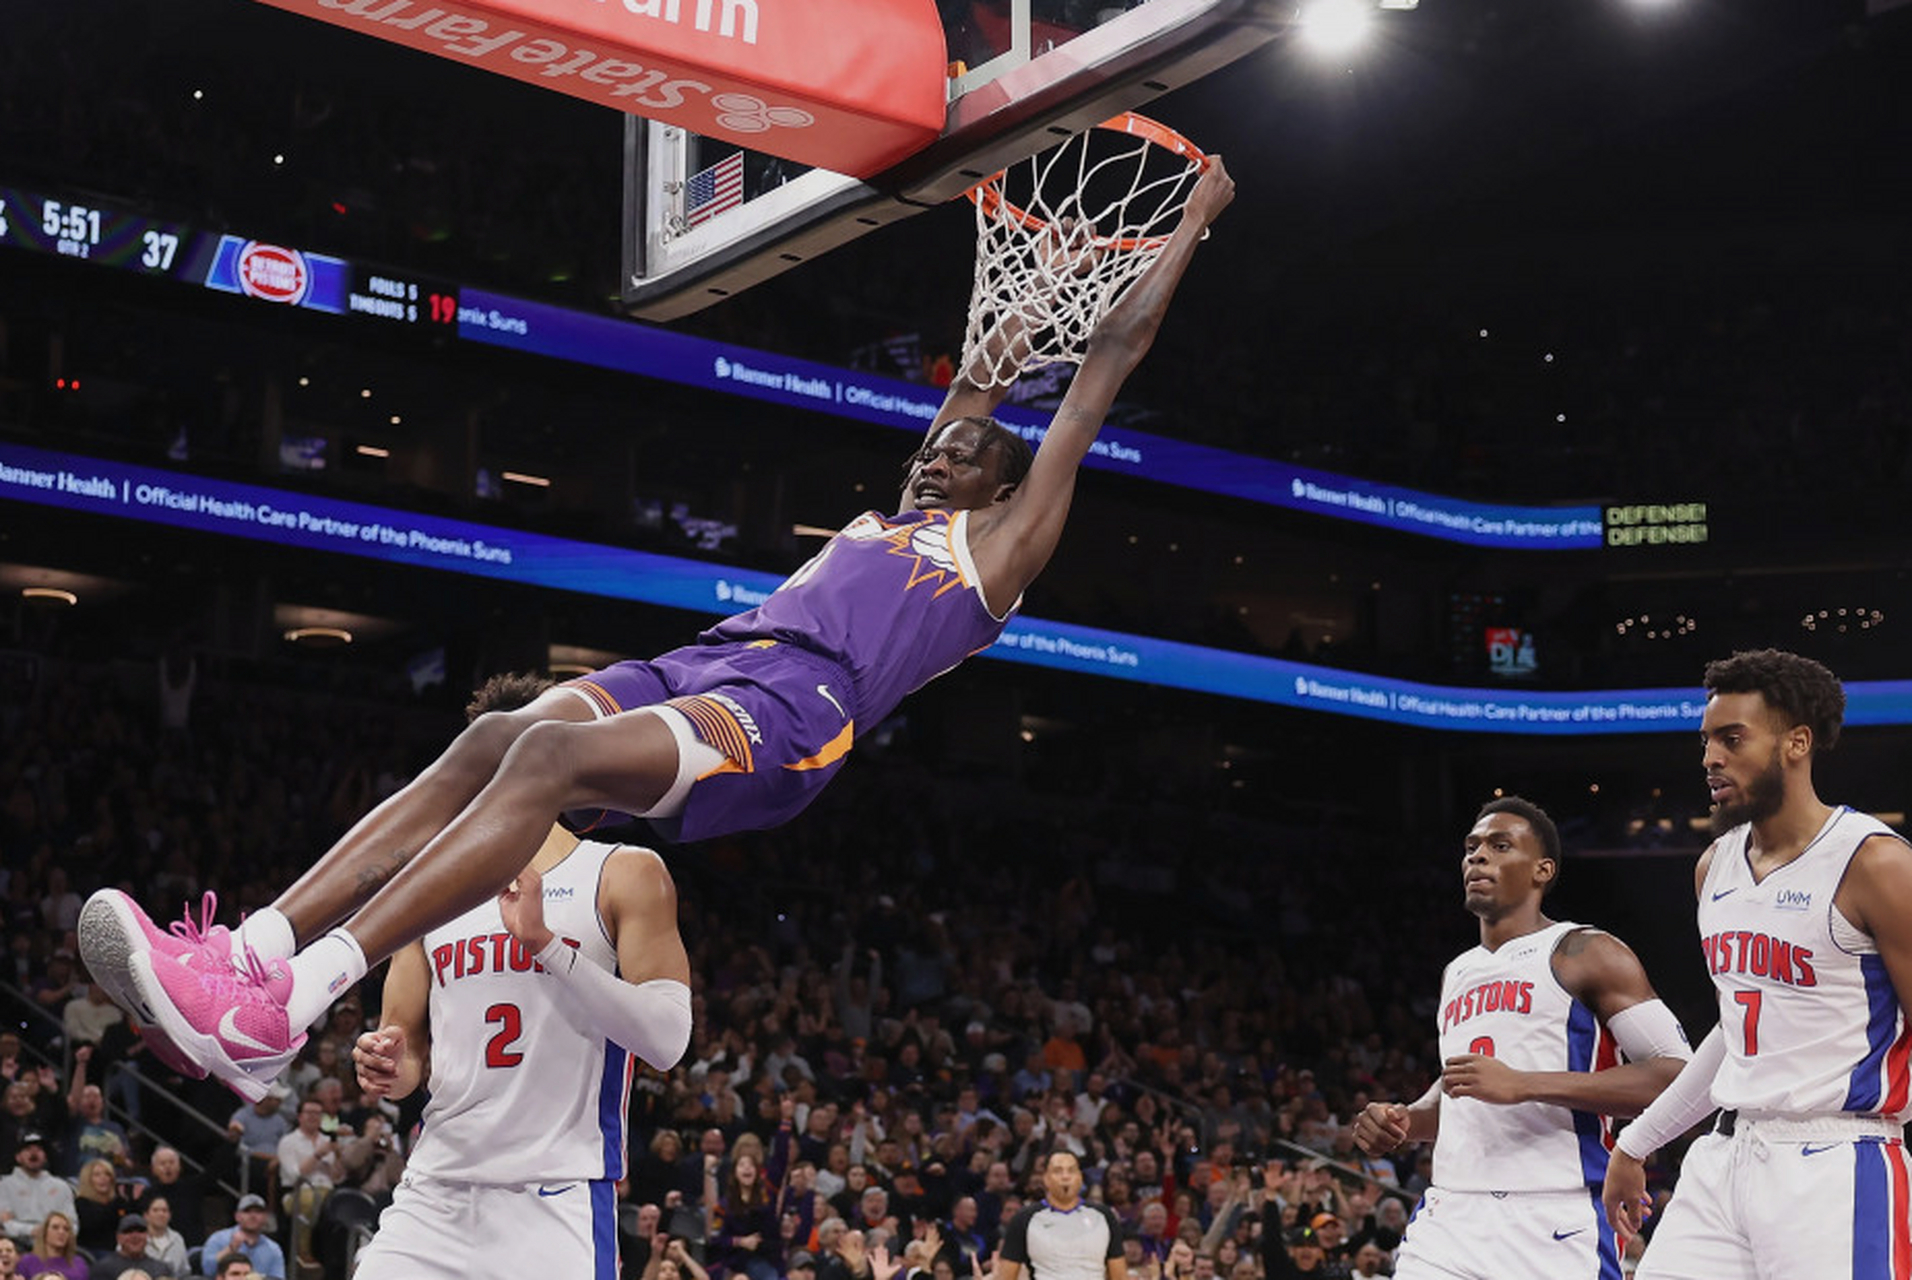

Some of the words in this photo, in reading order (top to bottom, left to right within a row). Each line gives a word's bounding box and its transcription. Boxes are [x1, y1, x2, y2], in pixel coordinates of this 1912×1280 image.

[42, 200, 100, 244] 5:51
[142, 230, 178, 270] 37
[429, 293, 456, 323] 19
[489, 309, 528, 335] Suns
[732, 363, 783, 389] Banner
[785, 373, 831, 399] Health
[845, 386, 894, 411] Official
[1110, 441, 1141, 463] Suns
[57, 472, 116, 499] Health
[135, 484, 197, 512] Official
[199, 495, 255, 521] Health
[257, 505, 297, 528] Care
[299, 512, 359, 538] Partner
[360, 524, 380, 541] of
[380, 526, 407, 546] the
[409, 530, 471, 557] Phoenix
[473, 541, 512, 564] Suns
[1306, 483, 1347, 506] Banner
[1348, 491, 1386, 514] Health
[1396, 501, 1434, 523] Official
[1472, 516, 1503, 533] Care
[1505, 519, 1559, 537] Partner
[1035, 636, 1056, 653] the
[1057, 637, 1106, 661] Phoenix
[1107, 646, 1138, 667] Suns
[1350, 687, 1388, 708] Health
[1398, 694, 1437, 714] Official
[1484, 703, 1516, 719] Care
[1518, 704, 1571, 721] Partner
[1590, 705, 1617, 721] the
[1619, 703, 1678, 719] Phoenix
[1776, 889, 1812, 906] UWM
[432, 932, 580, 989] PISTO
[1443, 980, 1534, 1036] PISTONS
[1734, 991, 1762, 1056] 7
[485, 1003, 524, 1068] 2
